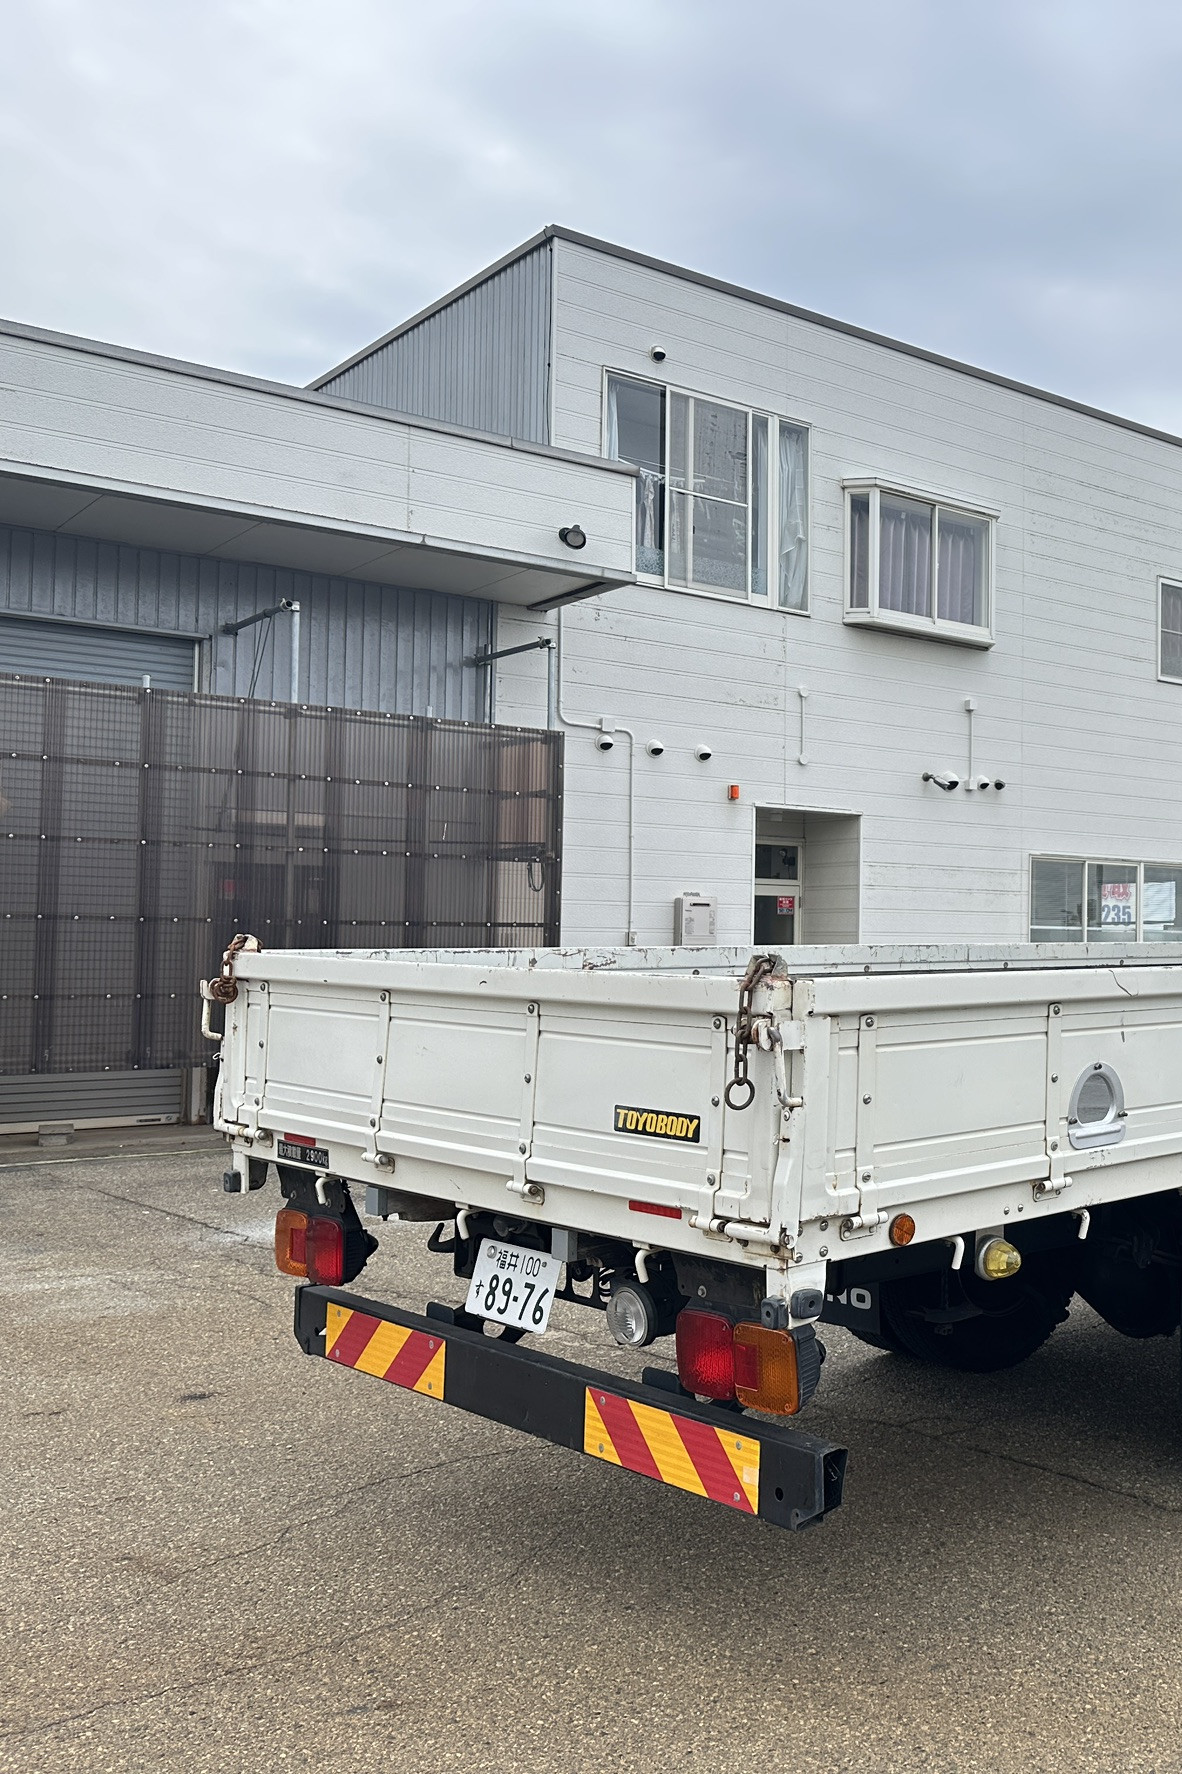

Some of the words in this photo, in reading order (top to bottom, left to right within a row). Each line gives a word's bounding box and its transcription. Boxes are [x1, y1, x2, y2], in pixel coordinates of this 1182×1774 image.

[616, 1108, 699, 1138] TOYOBODY
[475, 1280, 484, 1299] す
[484, 1274, 550, 1325] 89-76
